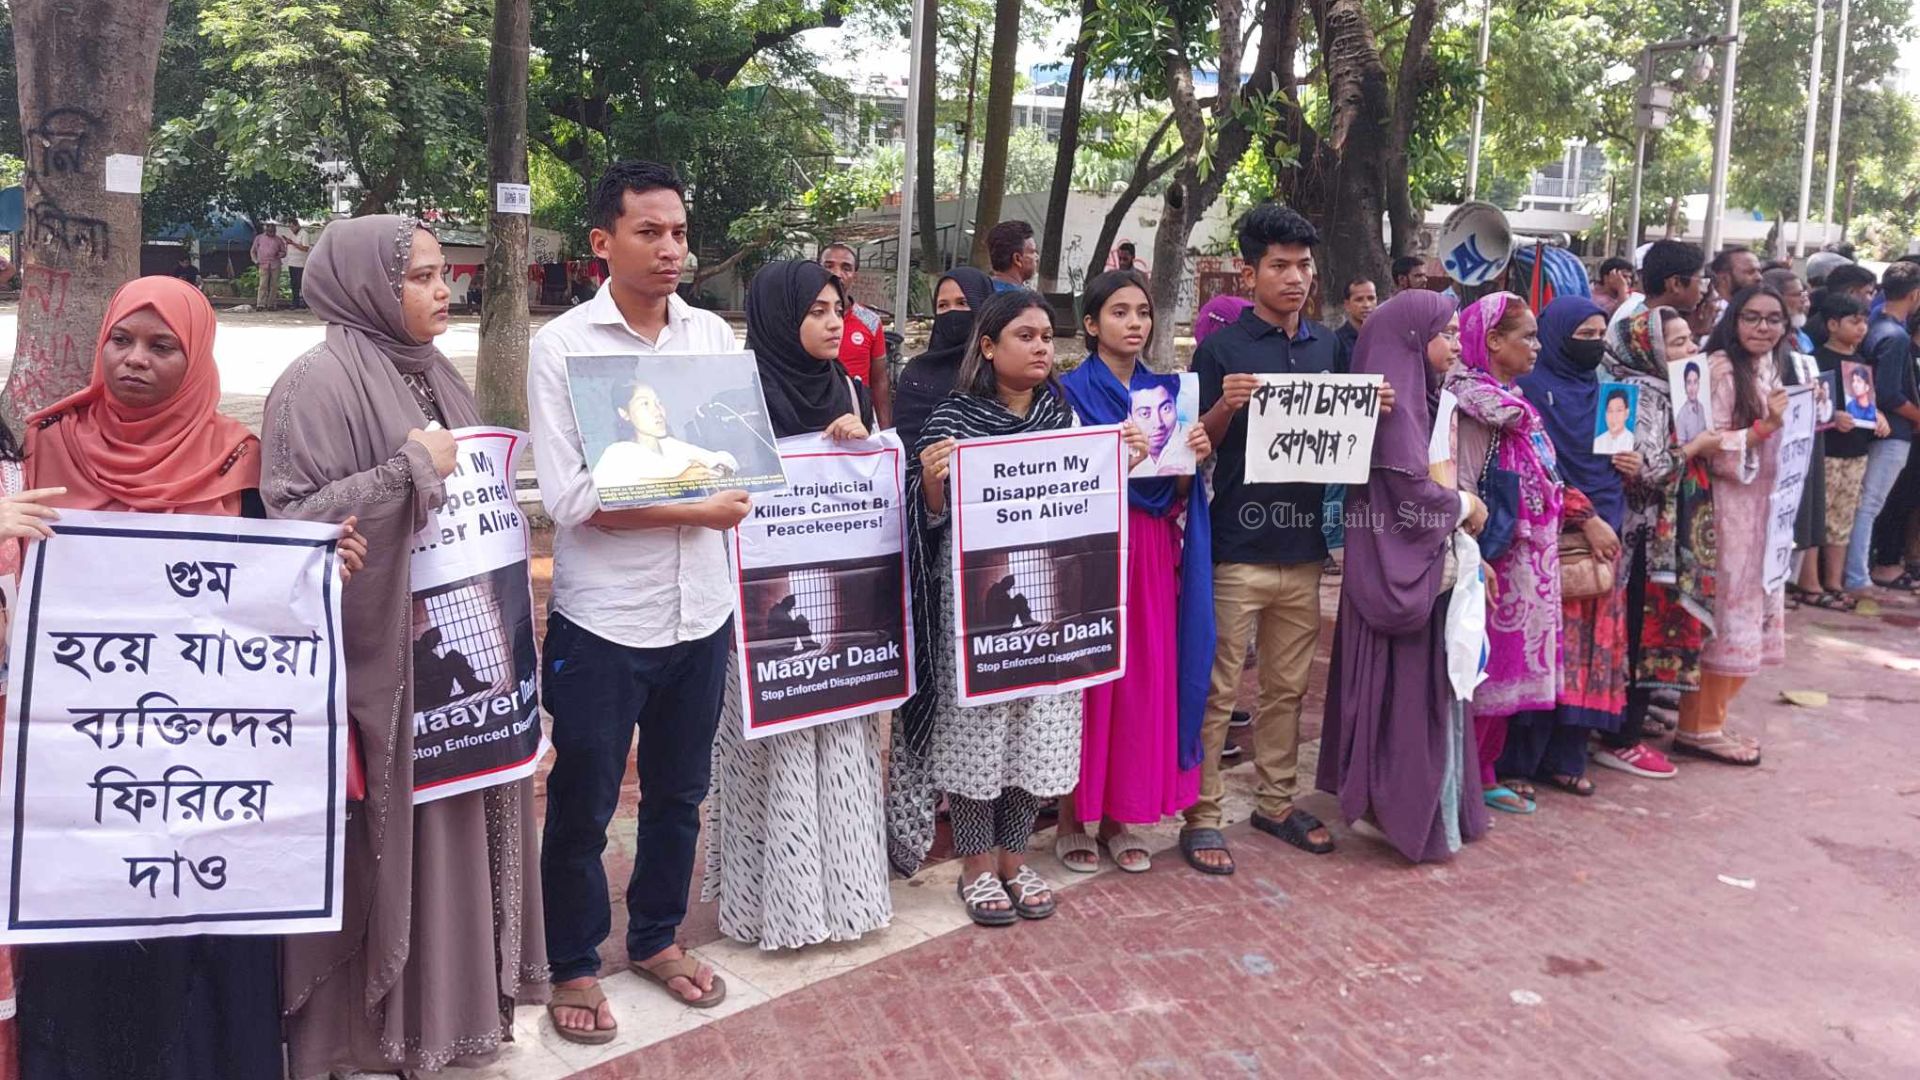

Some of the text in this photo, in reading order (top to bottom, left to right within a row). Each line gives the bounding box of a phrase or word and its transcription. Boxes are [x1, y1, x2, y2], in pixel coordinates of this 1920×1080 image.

[1314, 382, 1379, 418] চাকমা
[1268, 428, 1357, 465] কোথায় ?
[470, 451, 495, 477] My
[993, 455, 1089, 479] Return My
[433, 480, 509, 517] peared
[773, 480, 874, 499] trajudicial
[982, 475, 1100, 503] Disappeared
[478, 511, 519, 536] Alive
[755, 497, 890, 519] Killers Cannot Be
[996, 498, 1089, 524] Son Alive!
[766, 515, 884, 538] Peacekeepers!
[165, 561, 237, 604] গুম
[973, 616, 1115, 656] Maayer Daak
[47, 628, 324, 682] হয়ে যাওয়া
[756, 640, 901, 683] Maayer Daak
[976, 642, 1113, 674] Stop Enforced Disappearances
[761, 669, 899, 702] Stop Enforced Disappearances
[66, 691, 297, 750] ব্যক্তিদের
[444, 725, 511, 752] Enforced
[86, 764, 275, 824] ফিরিয়ে
[122, 849, 228, 899] দাও
